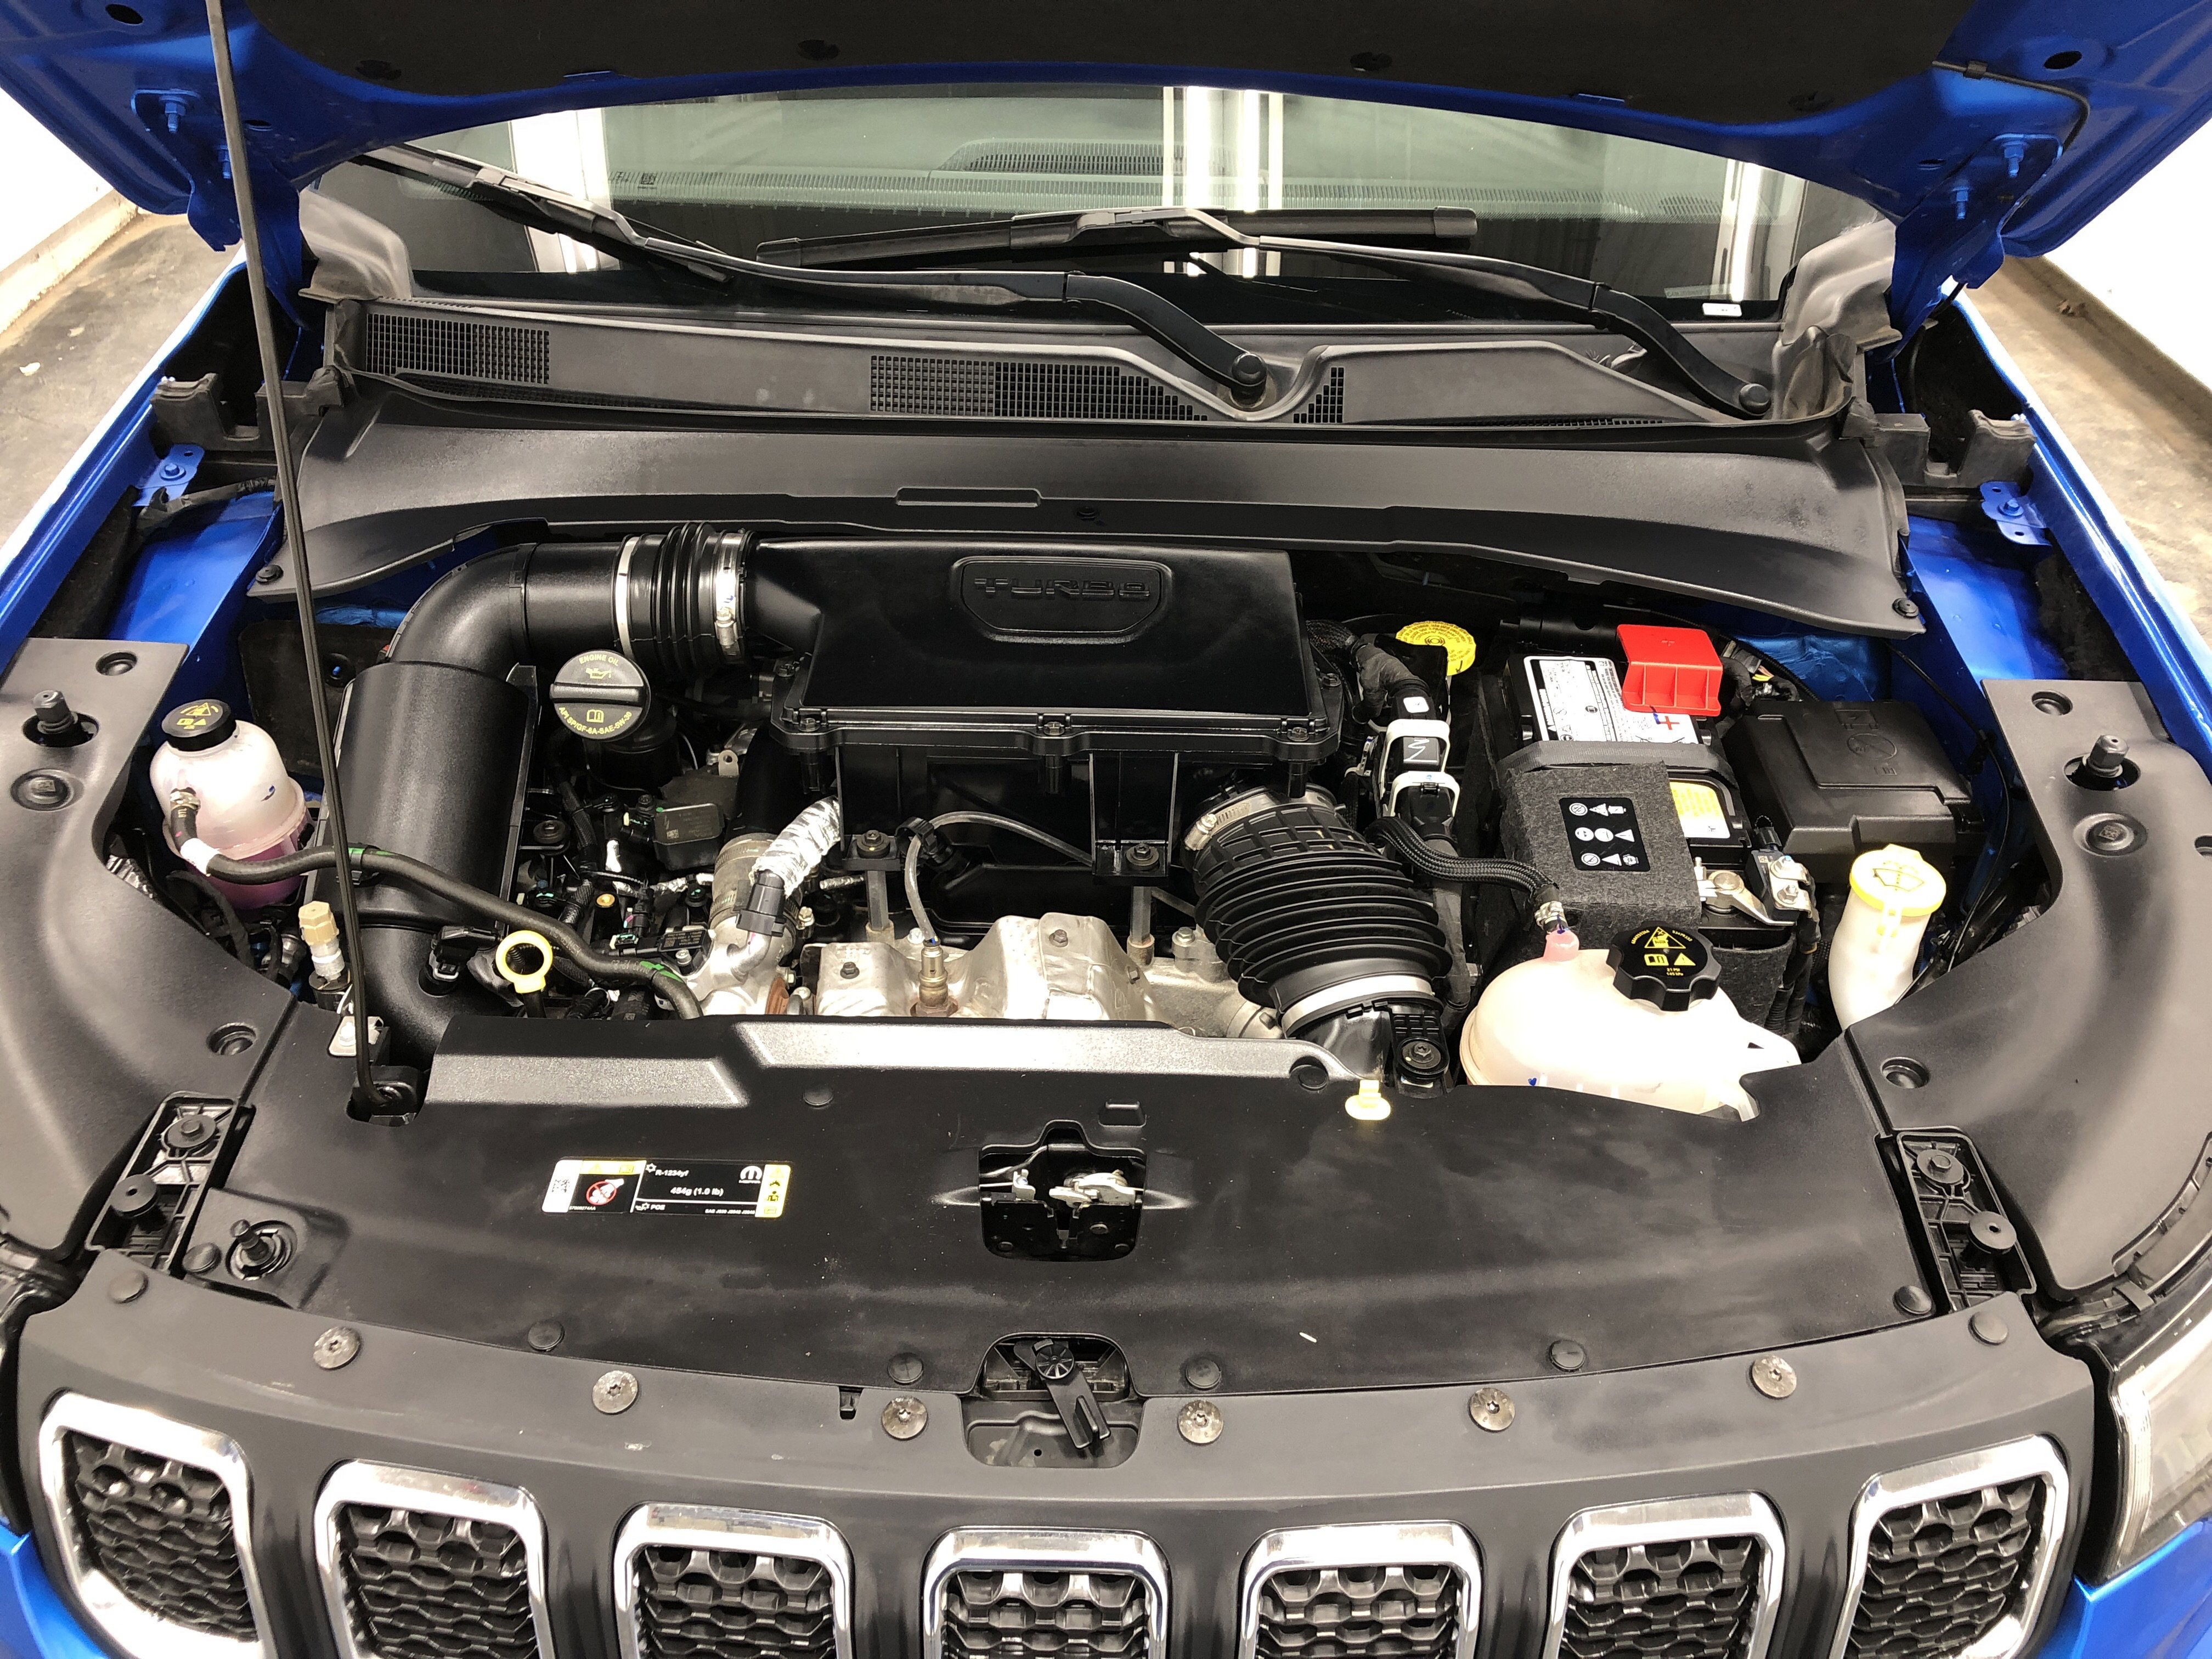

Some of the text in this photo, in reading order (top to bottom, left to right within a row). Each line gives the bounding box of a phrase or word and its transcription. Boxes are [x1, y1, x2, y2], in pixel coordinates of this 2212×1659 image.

[974, 578, 1150, 597] TURBO
[579, 654, 619, 667] ENGINE OIL
[558, 707, 568, 719] API
[655, 1170, 690, 1178] R-1234yf
[670, 1187, 724, 1197] 454g (1.0 lb)
